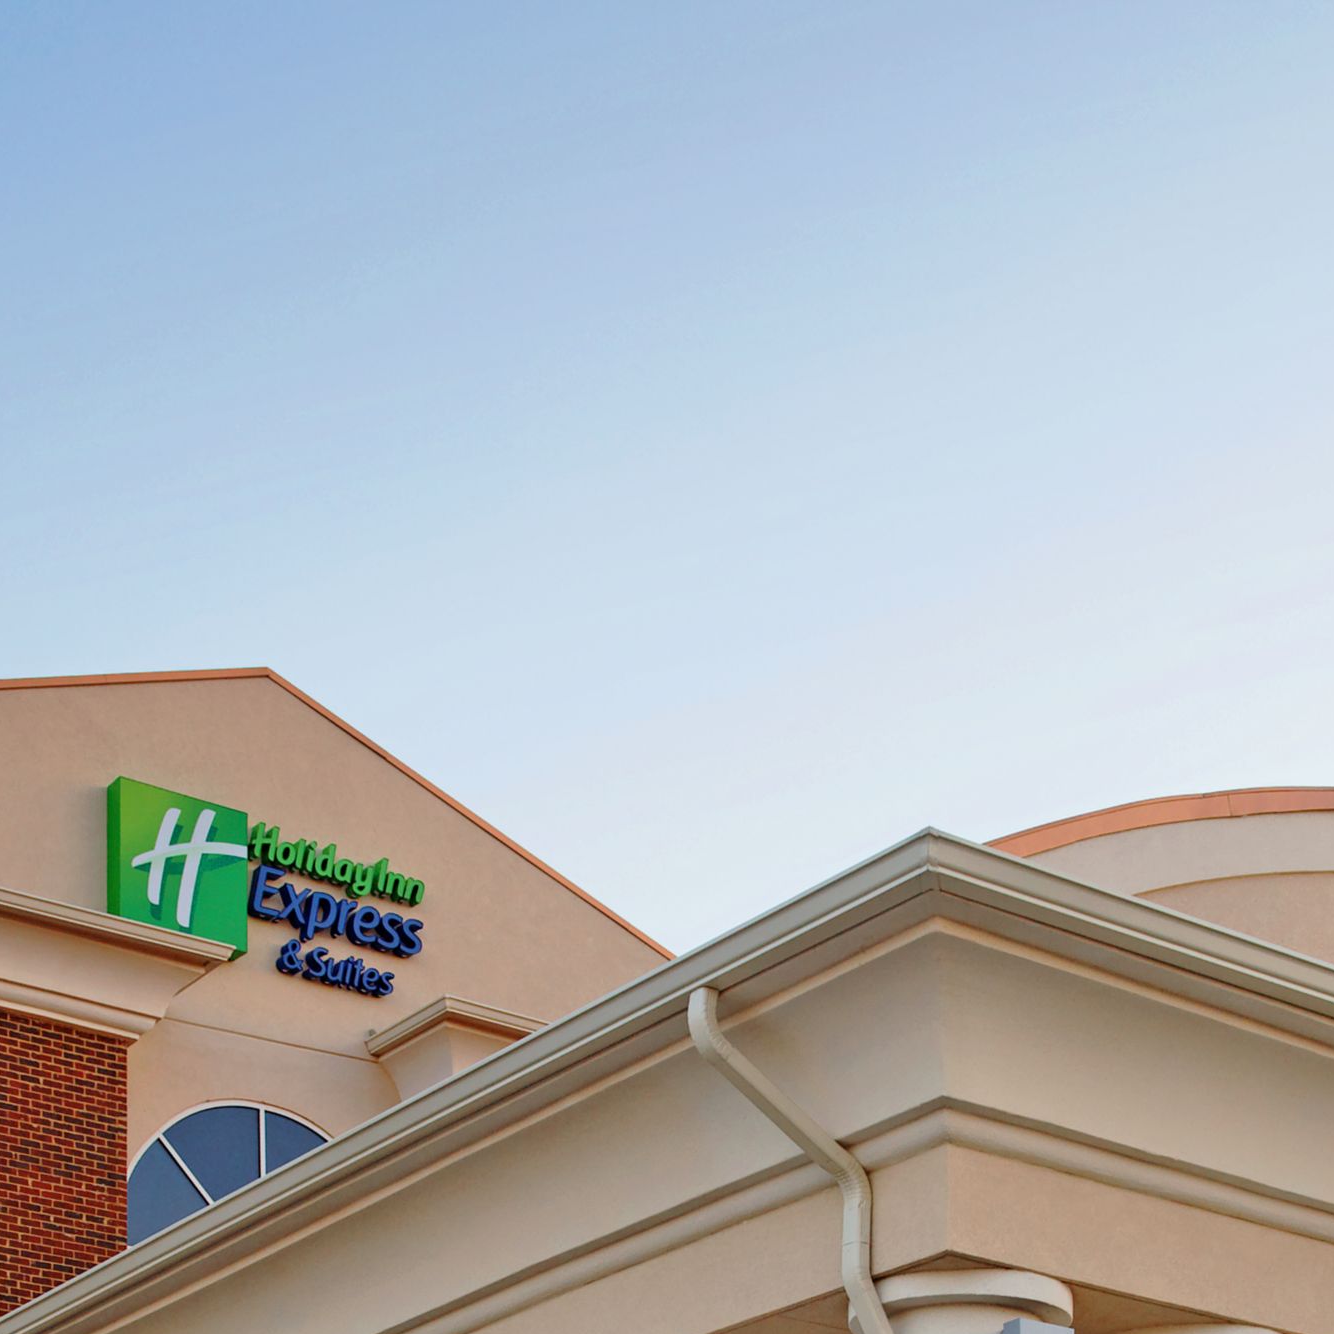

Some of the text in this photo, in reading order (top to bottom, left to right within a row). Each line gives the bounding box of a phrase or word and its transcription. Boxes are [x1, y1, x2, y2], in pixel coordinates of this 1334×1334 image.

[250, 822, 425, 905] Holiday Inn
[250, 864, 424, 957] Express
[277, 939, 395, 996] & Suites
